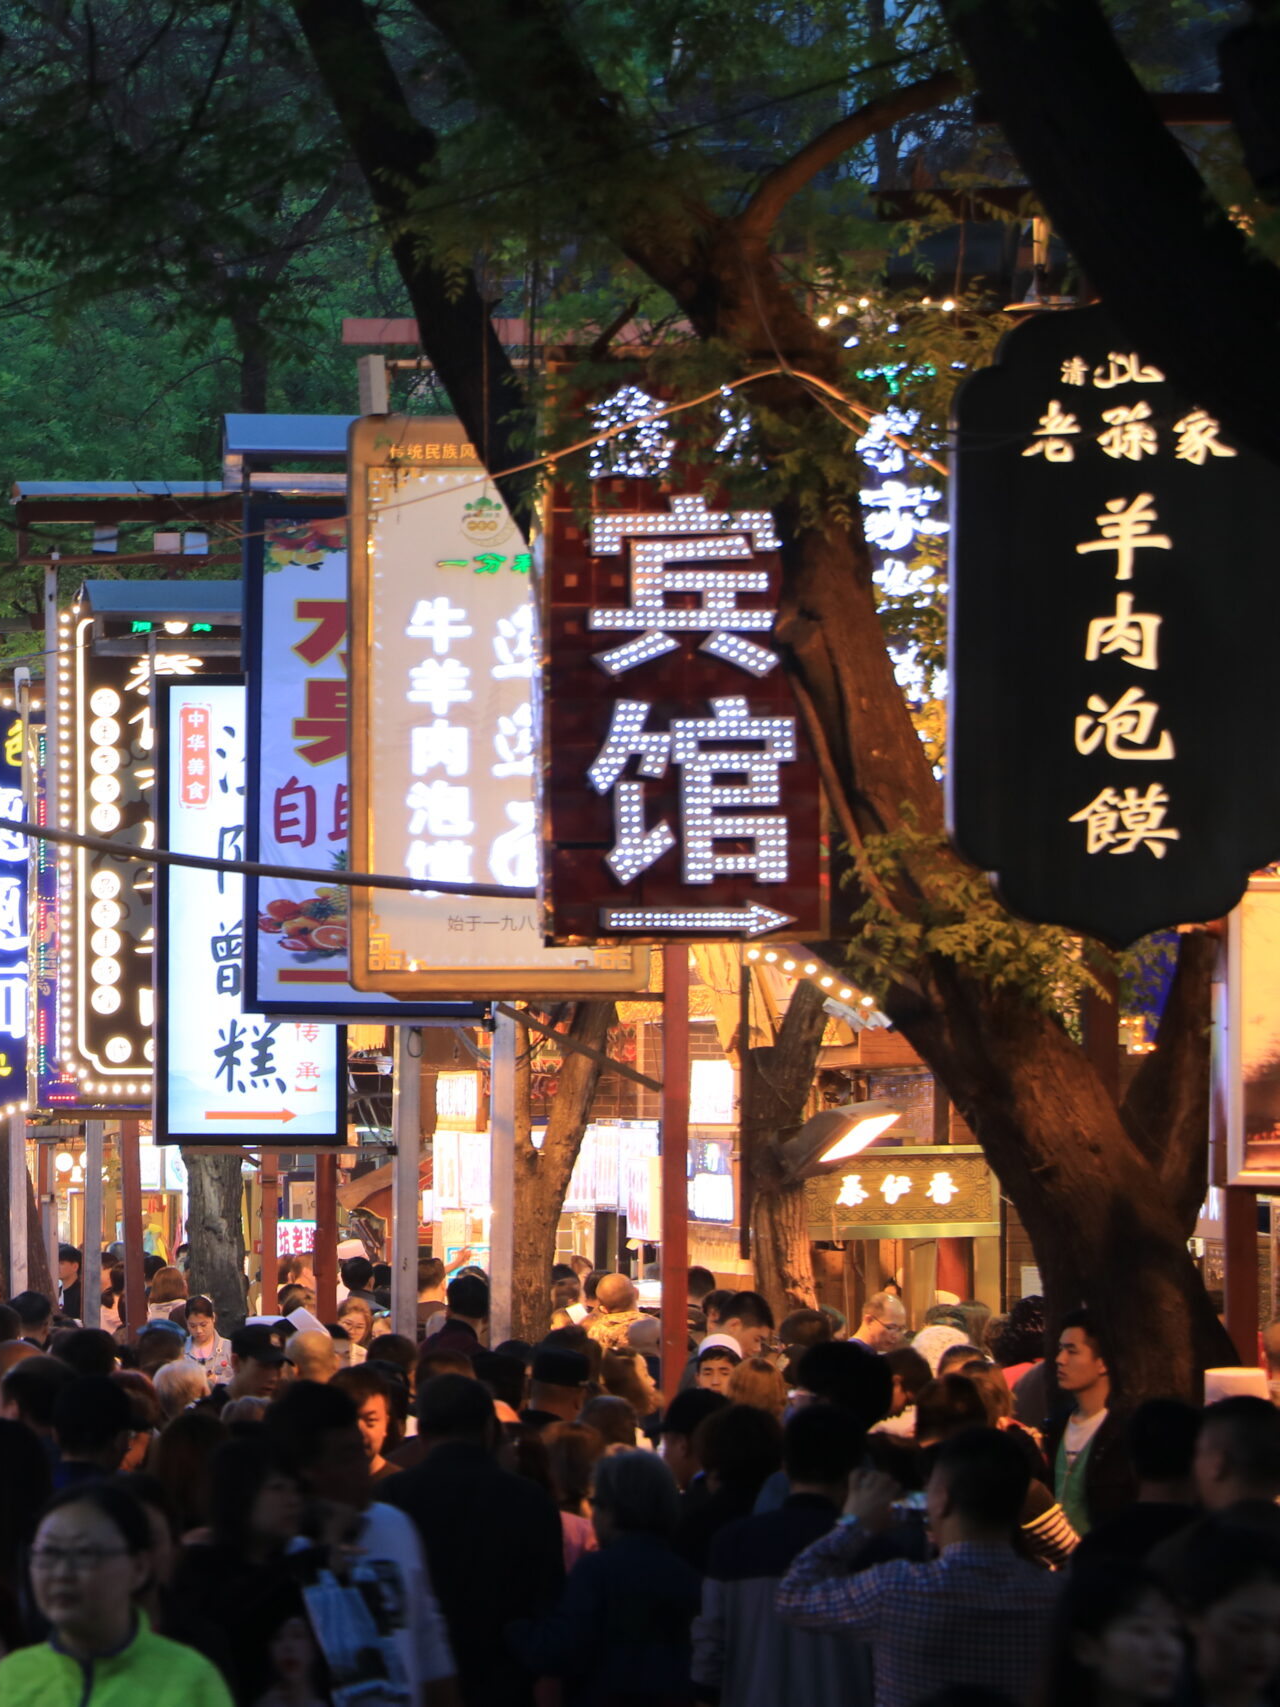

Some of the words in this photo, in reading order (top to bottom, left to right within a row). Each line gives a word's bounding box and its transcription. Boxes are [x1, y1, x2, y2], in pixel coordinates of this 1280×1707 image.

[1060, 356, 1090, 386] 清
[588, 495, 798, 885] 宾馆
[186, 708, 207, 801] 中华美食
[447, 914, 538, 932] 始于一九八
